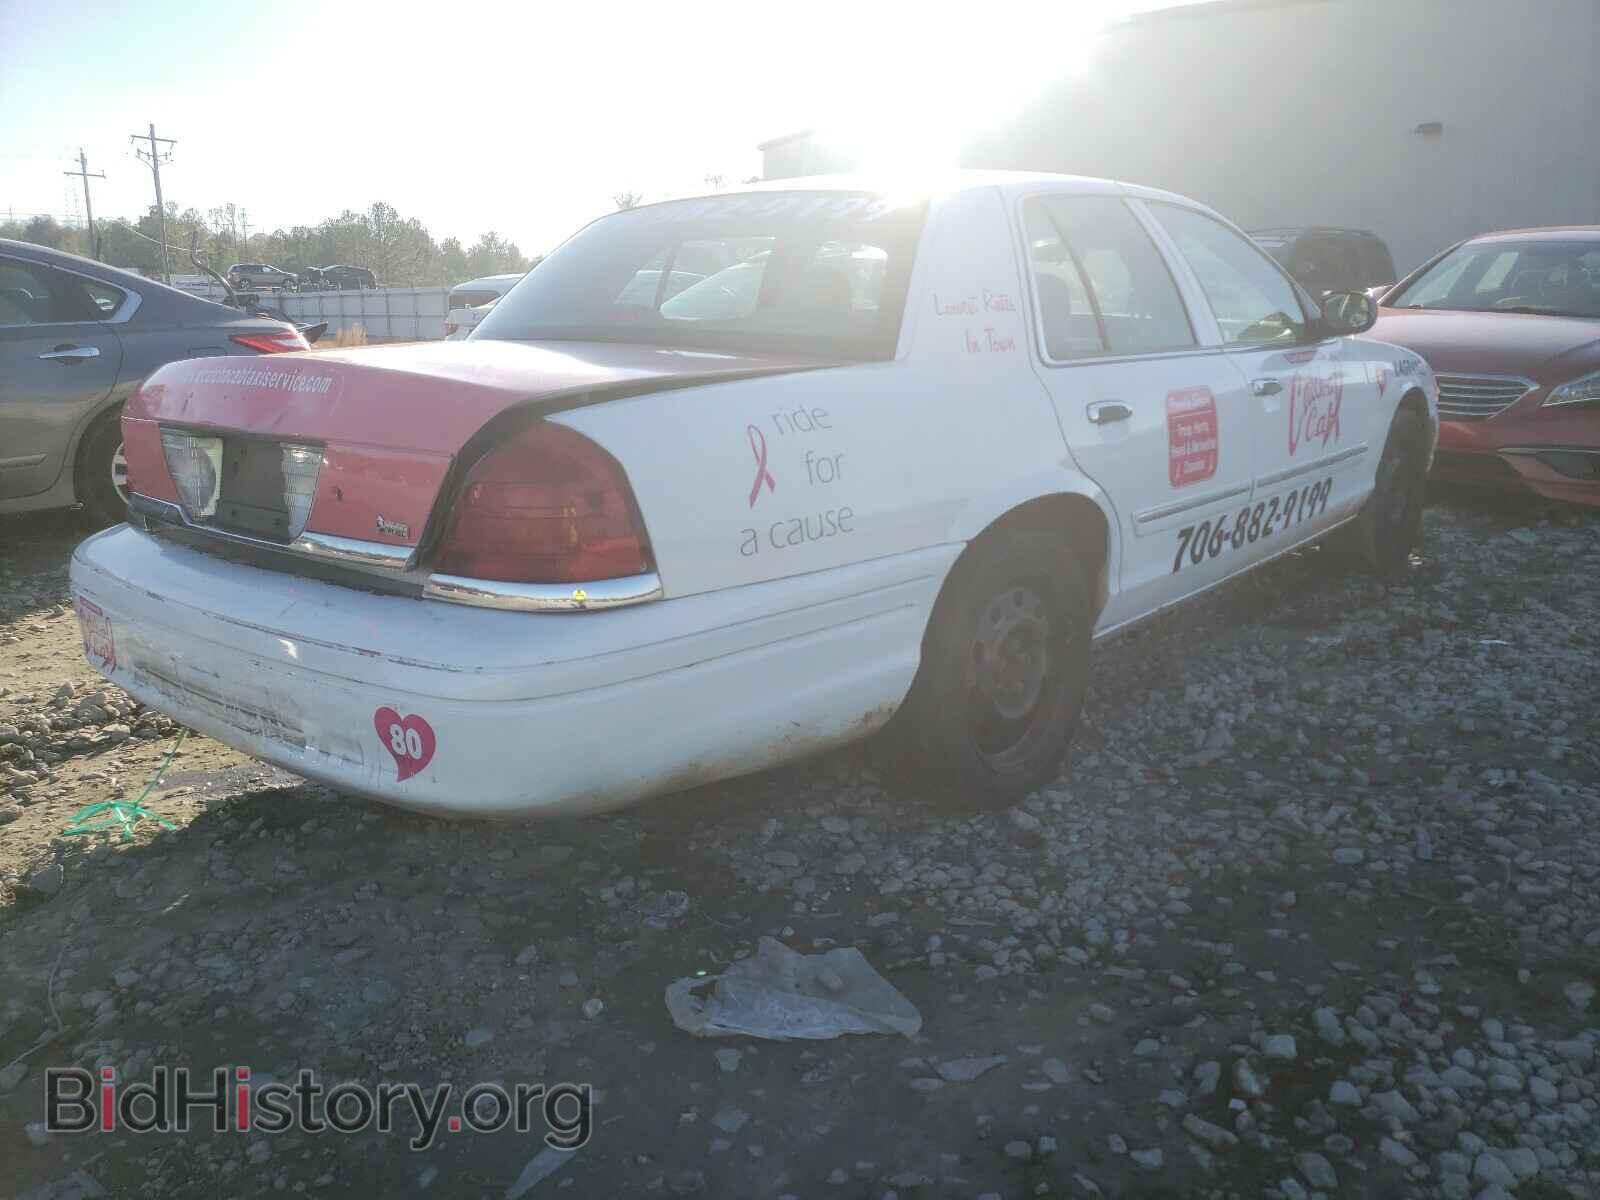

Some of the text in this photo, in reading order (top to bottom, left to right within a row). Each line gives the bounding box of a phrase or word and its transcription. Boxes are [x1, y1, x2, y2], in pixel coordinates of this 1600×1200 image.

[770, 404, 833, 436] ride
[805, 449, 846, 486] for
[739, 505, 854, 557] a cause
[1171, 477, 1334, 575] 706-882-9199
[390, 723, 422, 760] 80
